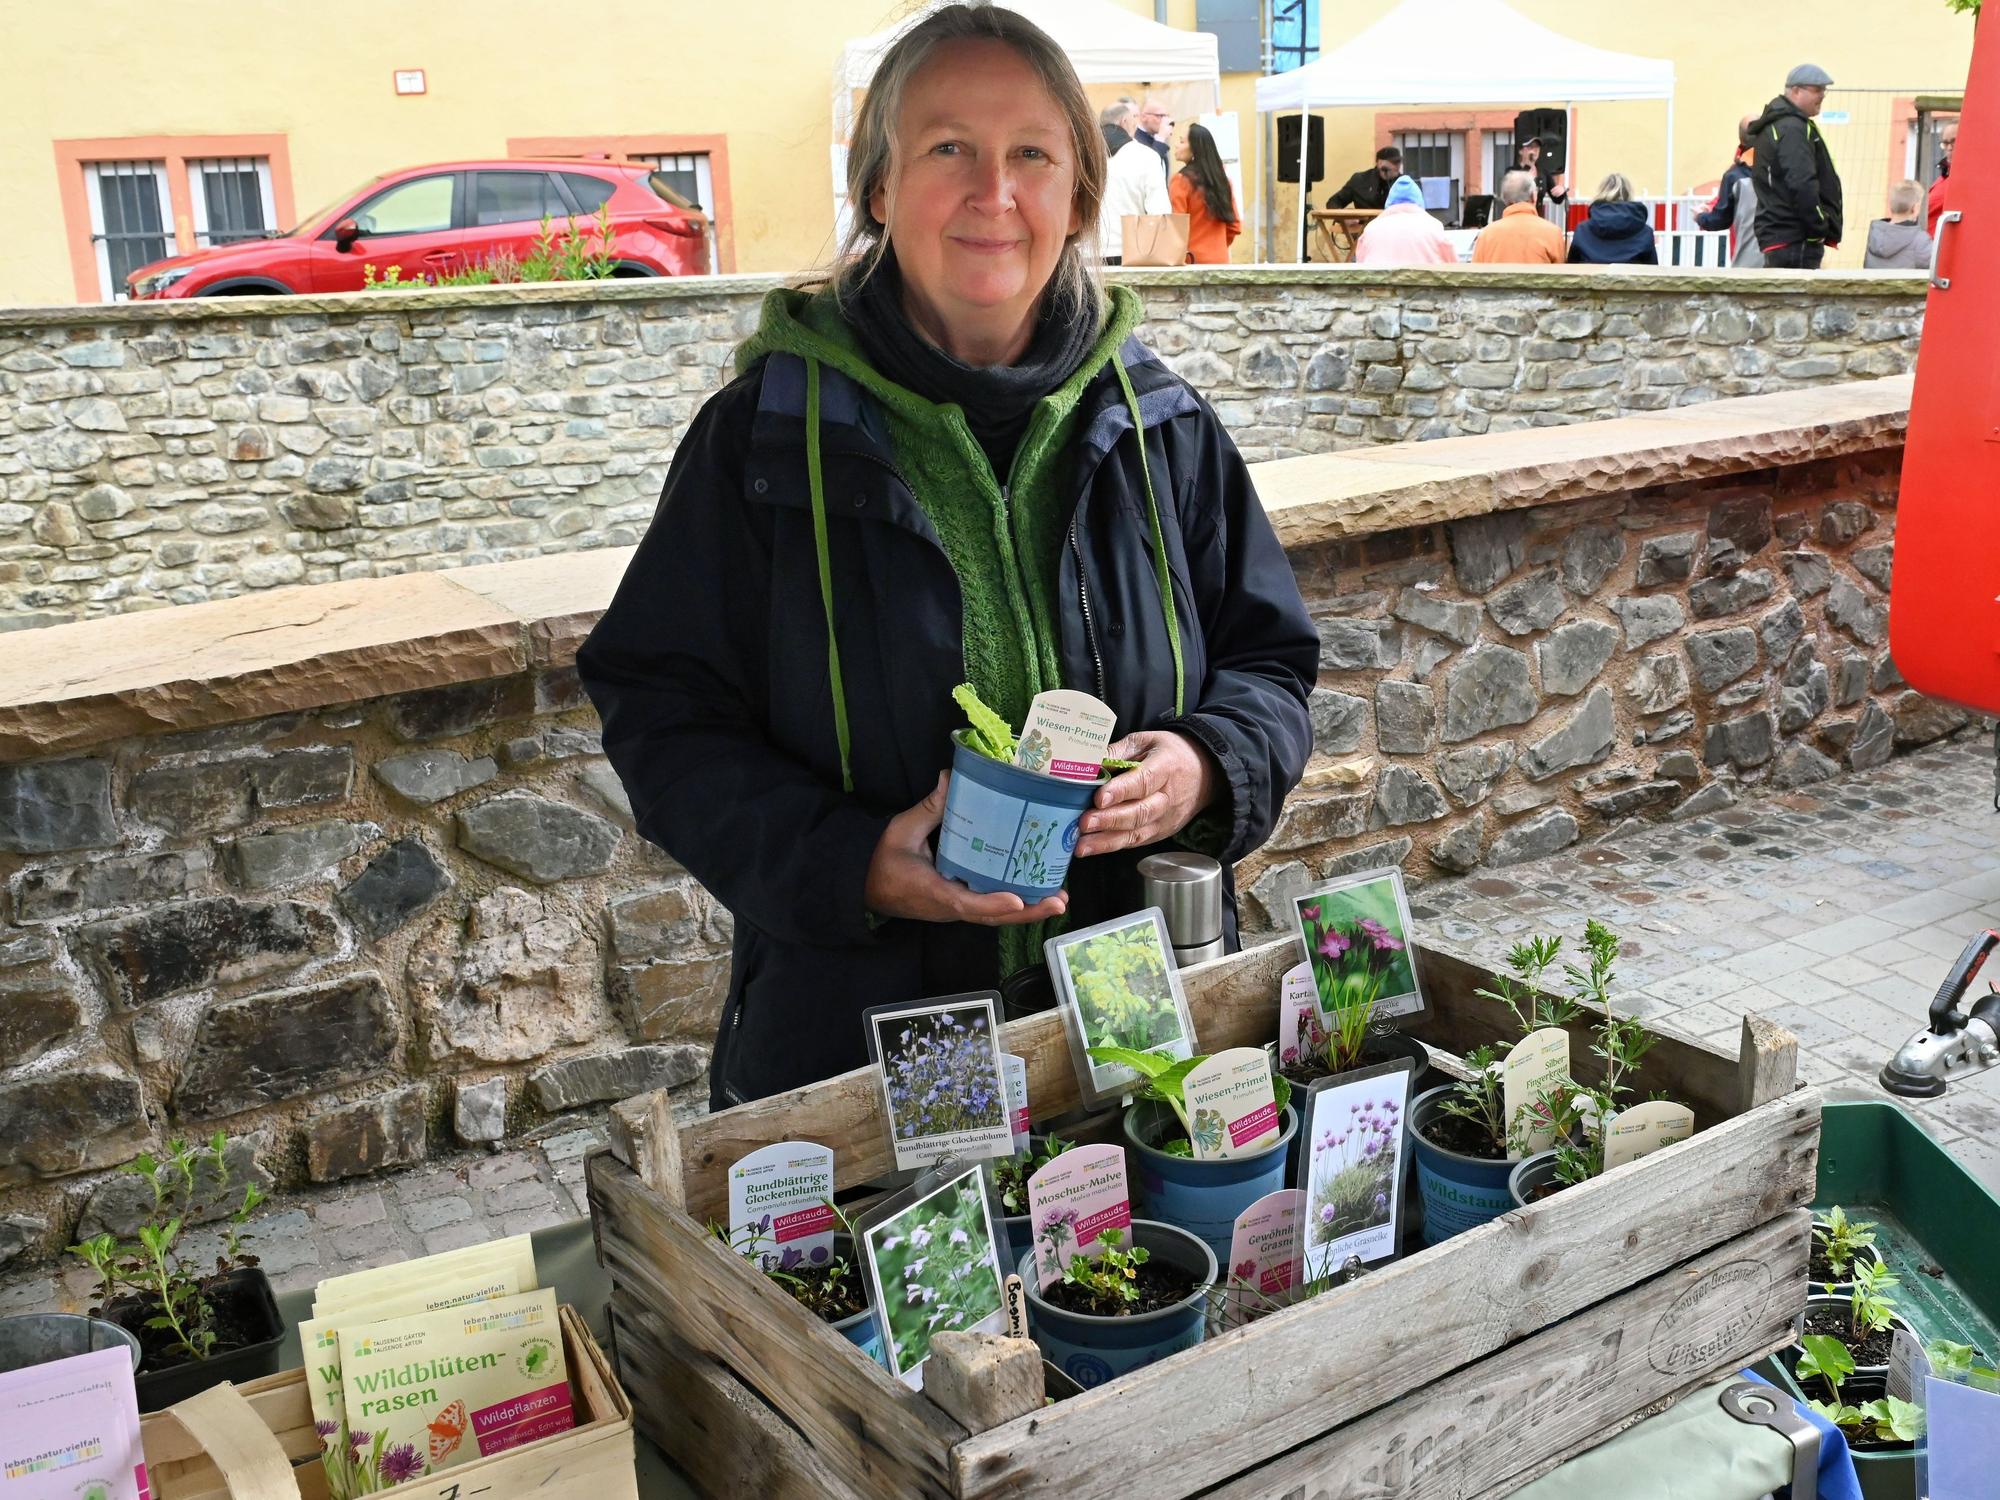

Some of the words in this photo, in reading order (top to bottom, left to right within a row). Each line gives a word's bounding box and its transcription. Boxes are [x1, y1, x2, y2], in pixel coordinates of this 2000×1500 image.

[1036, 716, 1107, 743] Wiesen-Primel
[1054, 761, 1095, 773] Wildstaude
[1194, 1072, 1268, 1105] Wiesen-Primel
[1231, 1107, 1272, 1132] Wildstaude
[897, 1139, 950, 1153] Rundblättrige
[951, 1132, 1008, 1145] Glockenblume
[745, 1184, 829, 1205] Glockenblume
[747, 1173, 829, 1194] Rundblättrige
[1036, 1171, 1122, 1207] Moschus-Malve
[777, 1208, 828, 1227] Wildstaude
[1077, 1205, 1124, 1230] Wildstaude
[1354, 1231, 1388, 1247] Grasnelke
[463, 1305, 543, 1326] leben.natur.vielfalt
[373, 1336, 403, 1347] TAUSENDE
[374, 1342, 403, 1354] TAUSENDE
[404, 1339, 423, 1349] ARTEN
[354, 1352, 506, 1394] Wildblüten-
[361, 1387, 438, 1417] rasen
[479, 1394, 557, 1427] Wildpflanzen
[4, 1437, 101, 1469] leben.natur.vielfalt
